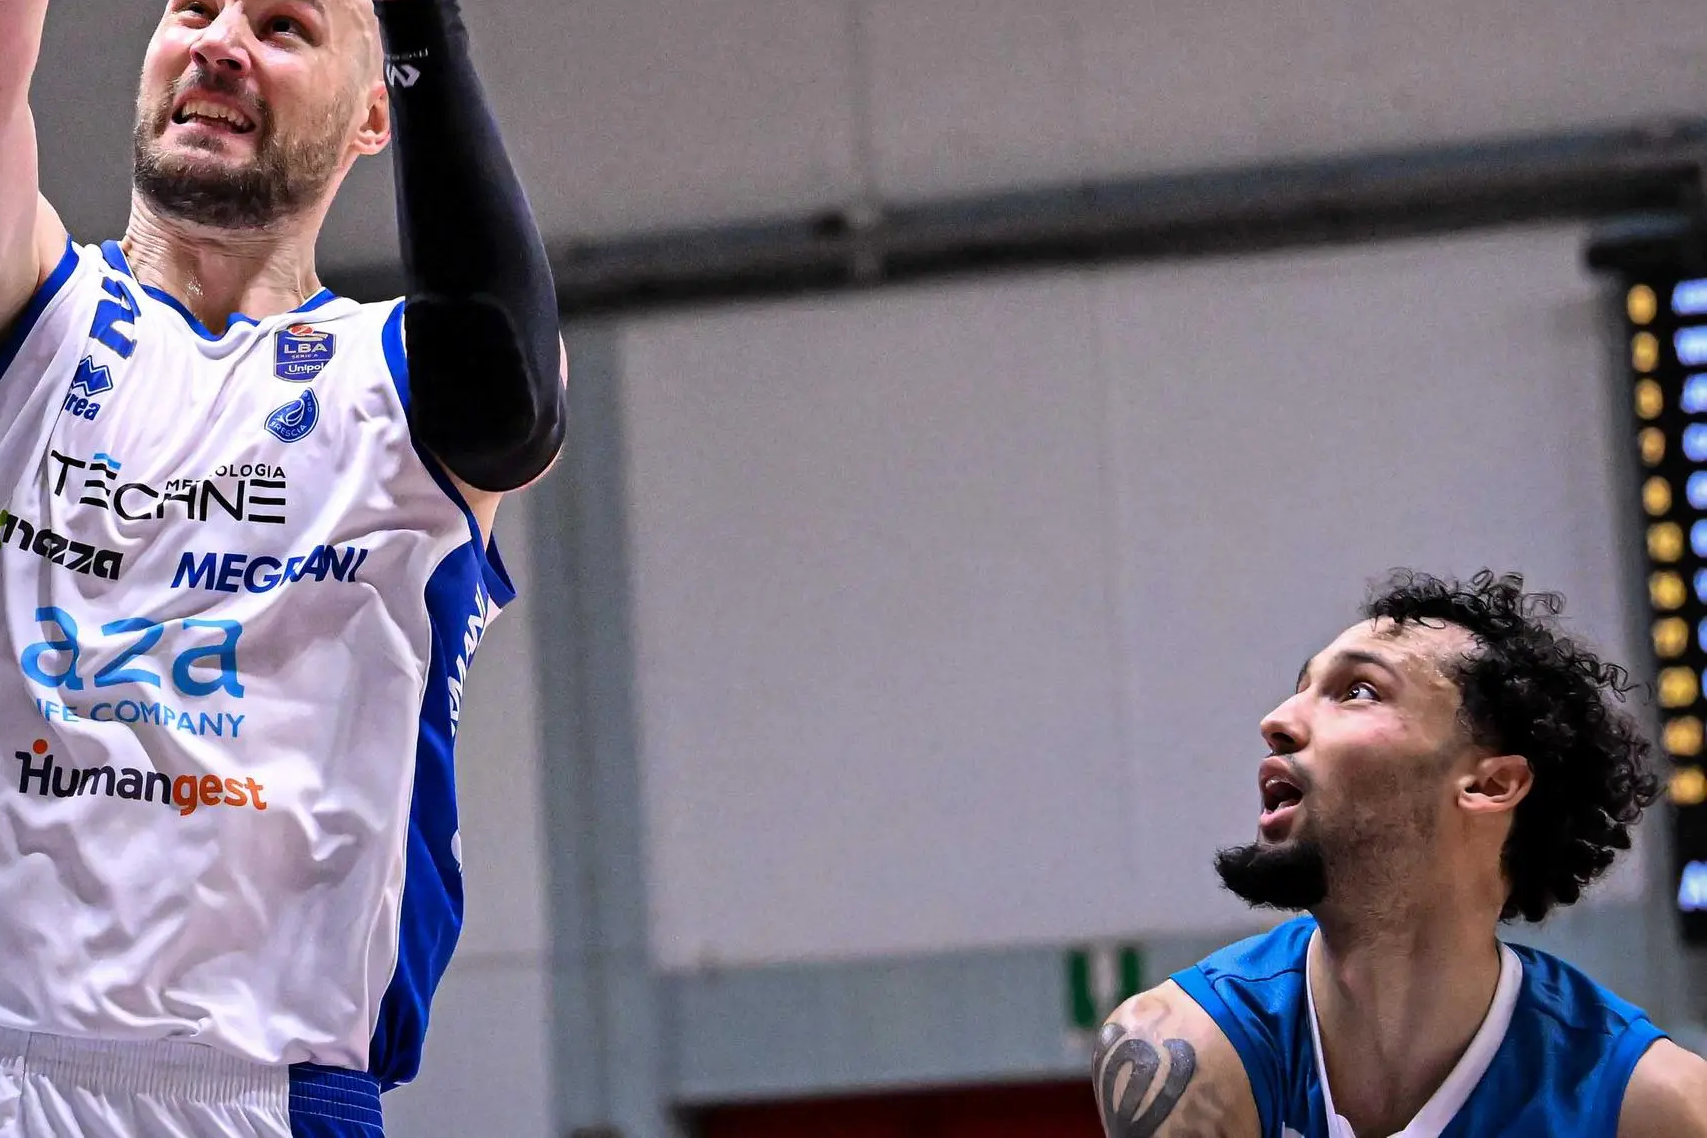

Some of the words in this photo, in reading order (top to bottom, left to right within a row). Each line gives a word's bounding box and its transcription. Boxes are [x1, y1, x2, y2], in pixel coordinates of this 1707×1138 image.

[284, 343, 327, 354] LBA
[288, 362, 324, 374] Unipol
[165, 463, 286, 492] MEOLOGIA
[20, 605, 245, 699] aza
[89, 700, 246, 738] COMPANY
[14, 738, 268, 817] Humangest
